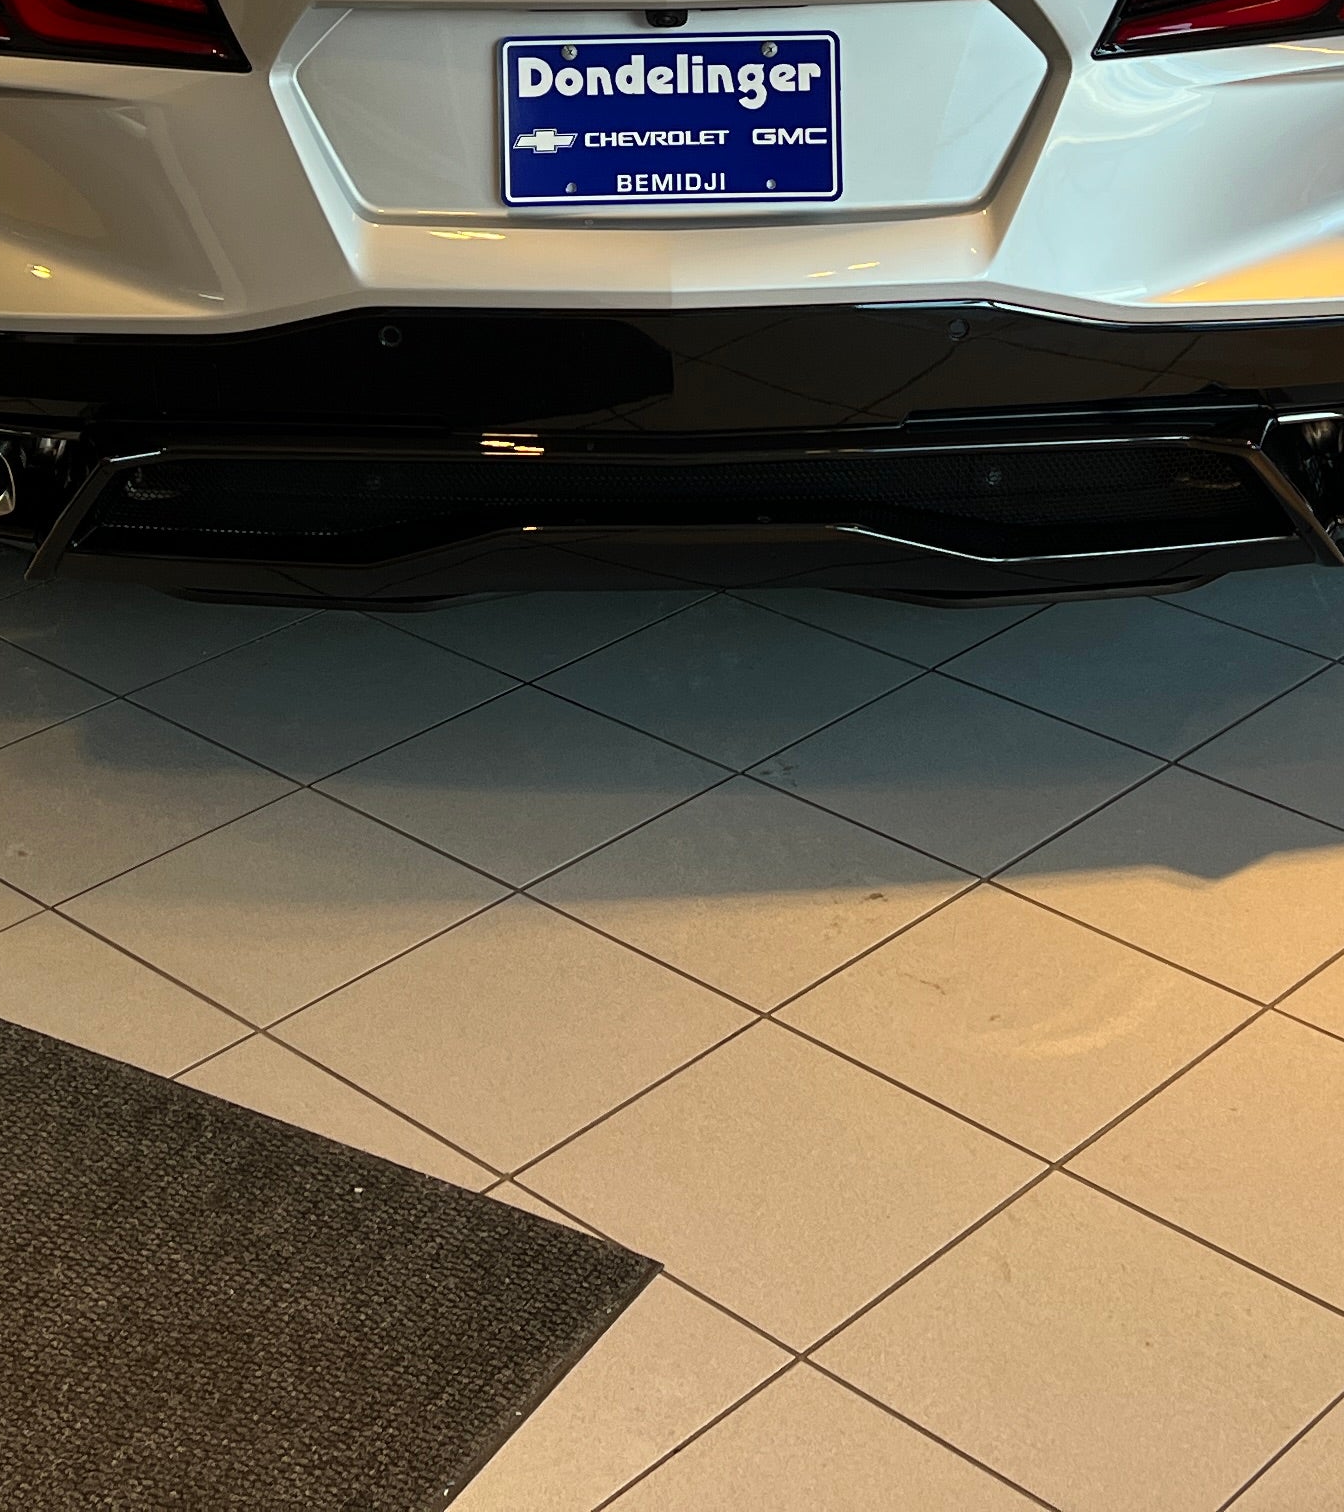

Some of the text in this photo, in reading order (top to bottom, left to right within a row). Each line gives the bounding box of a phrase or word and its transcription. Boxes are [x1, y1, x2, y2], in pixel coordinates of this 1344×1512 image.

[517, 54, 822, 110] Dondelinger
[584, 127, 828, 148] CHEVROLET GMC
[617, 172, 727, 193] BEMIDJI
